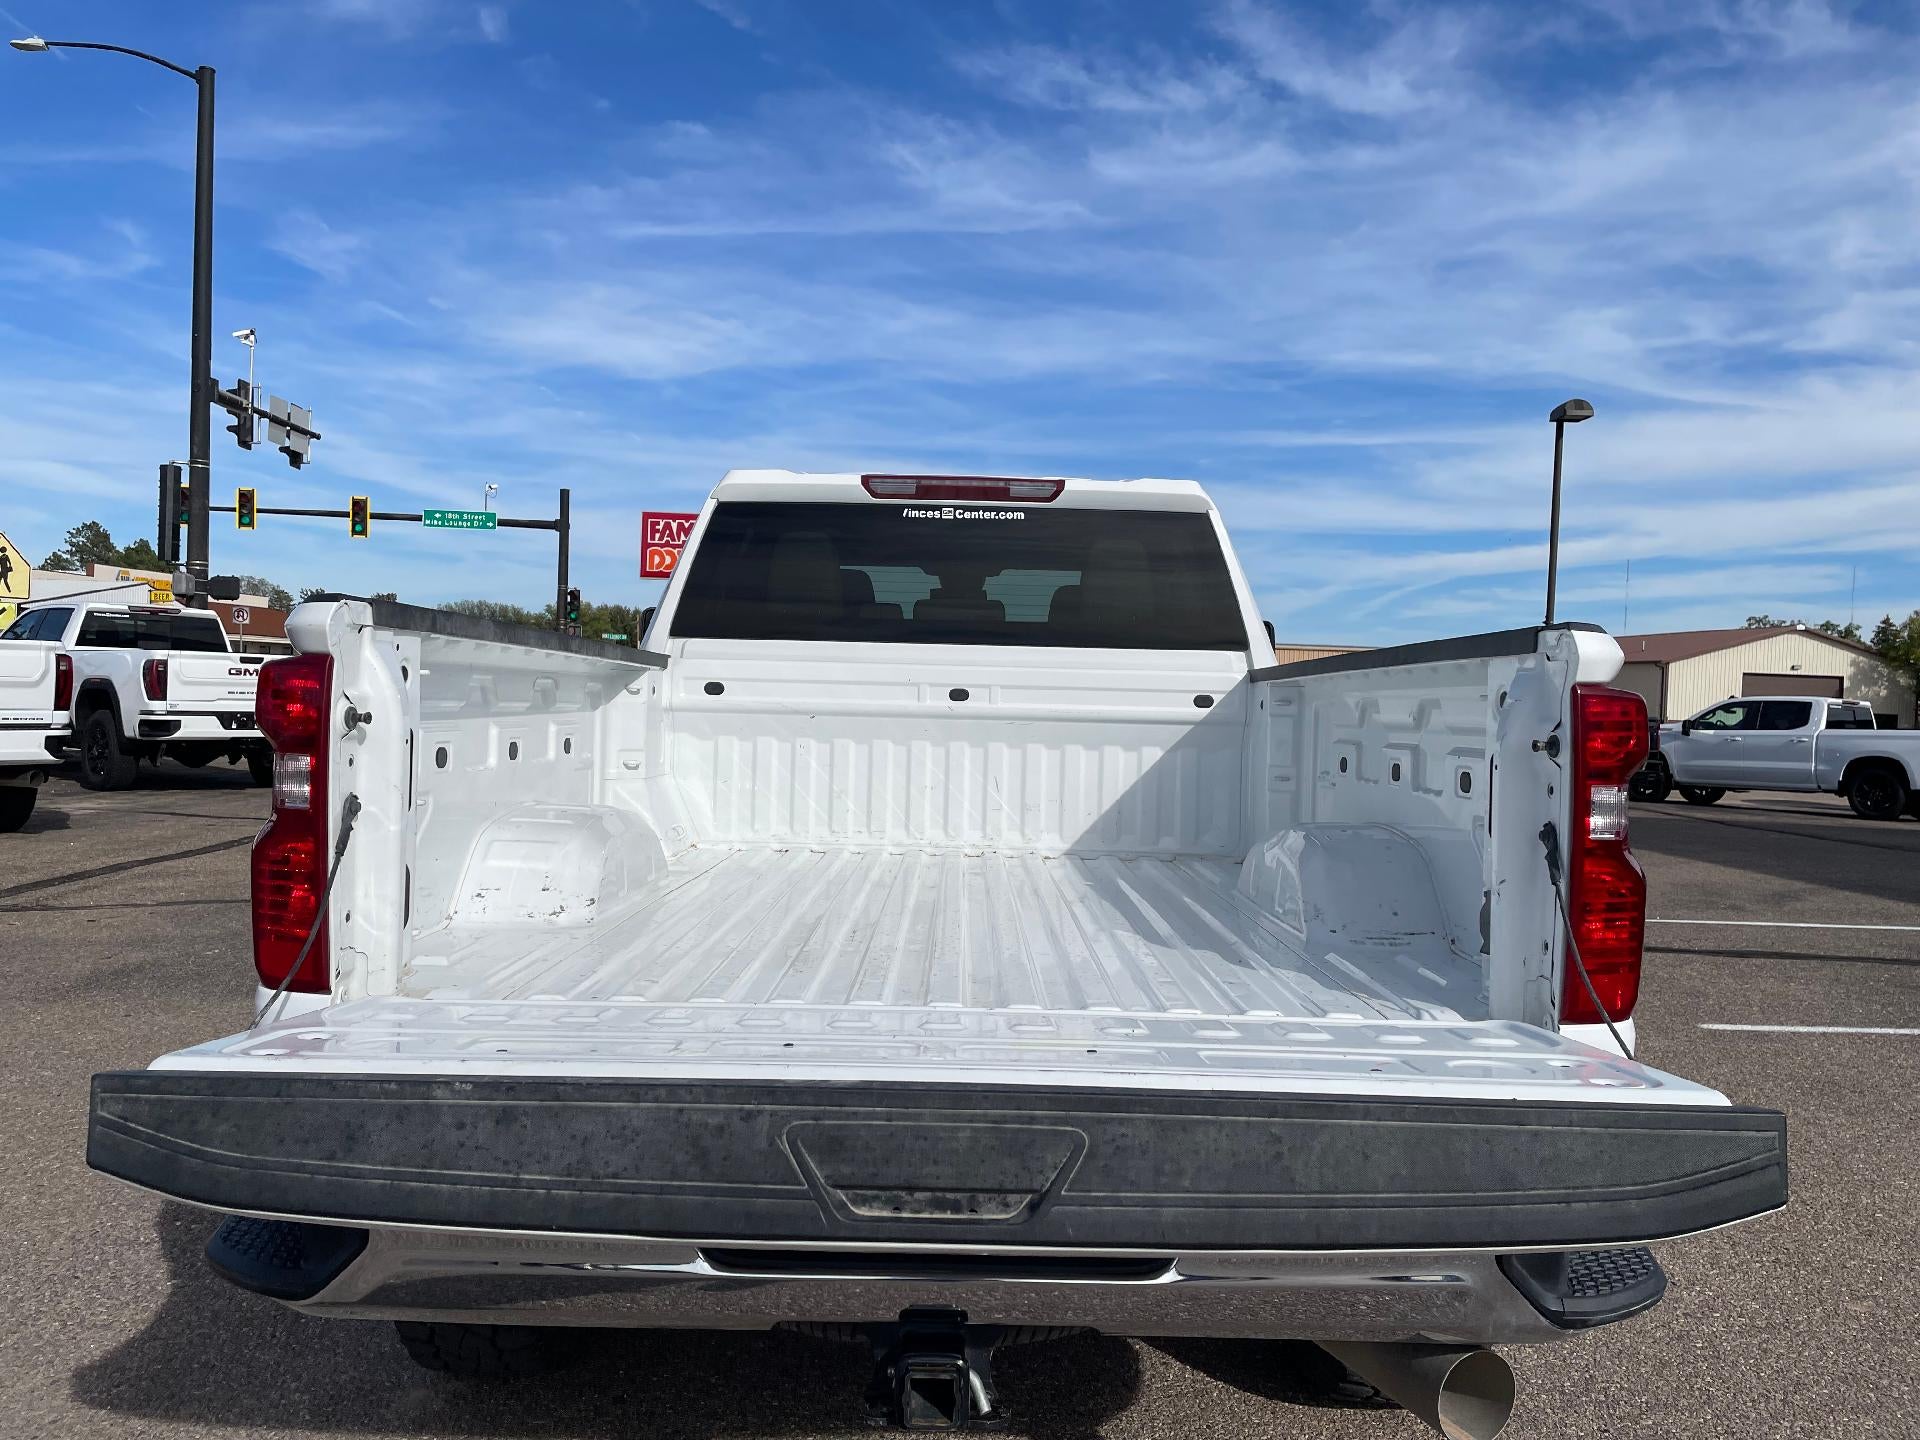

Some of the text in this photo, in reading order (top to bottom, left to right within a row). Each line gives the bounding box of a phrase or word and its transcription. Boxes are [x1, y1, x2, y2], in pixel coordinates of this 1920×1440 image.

[445, 512, 486, 521] 18th Street
[153, 592, 170, 601] BEER
